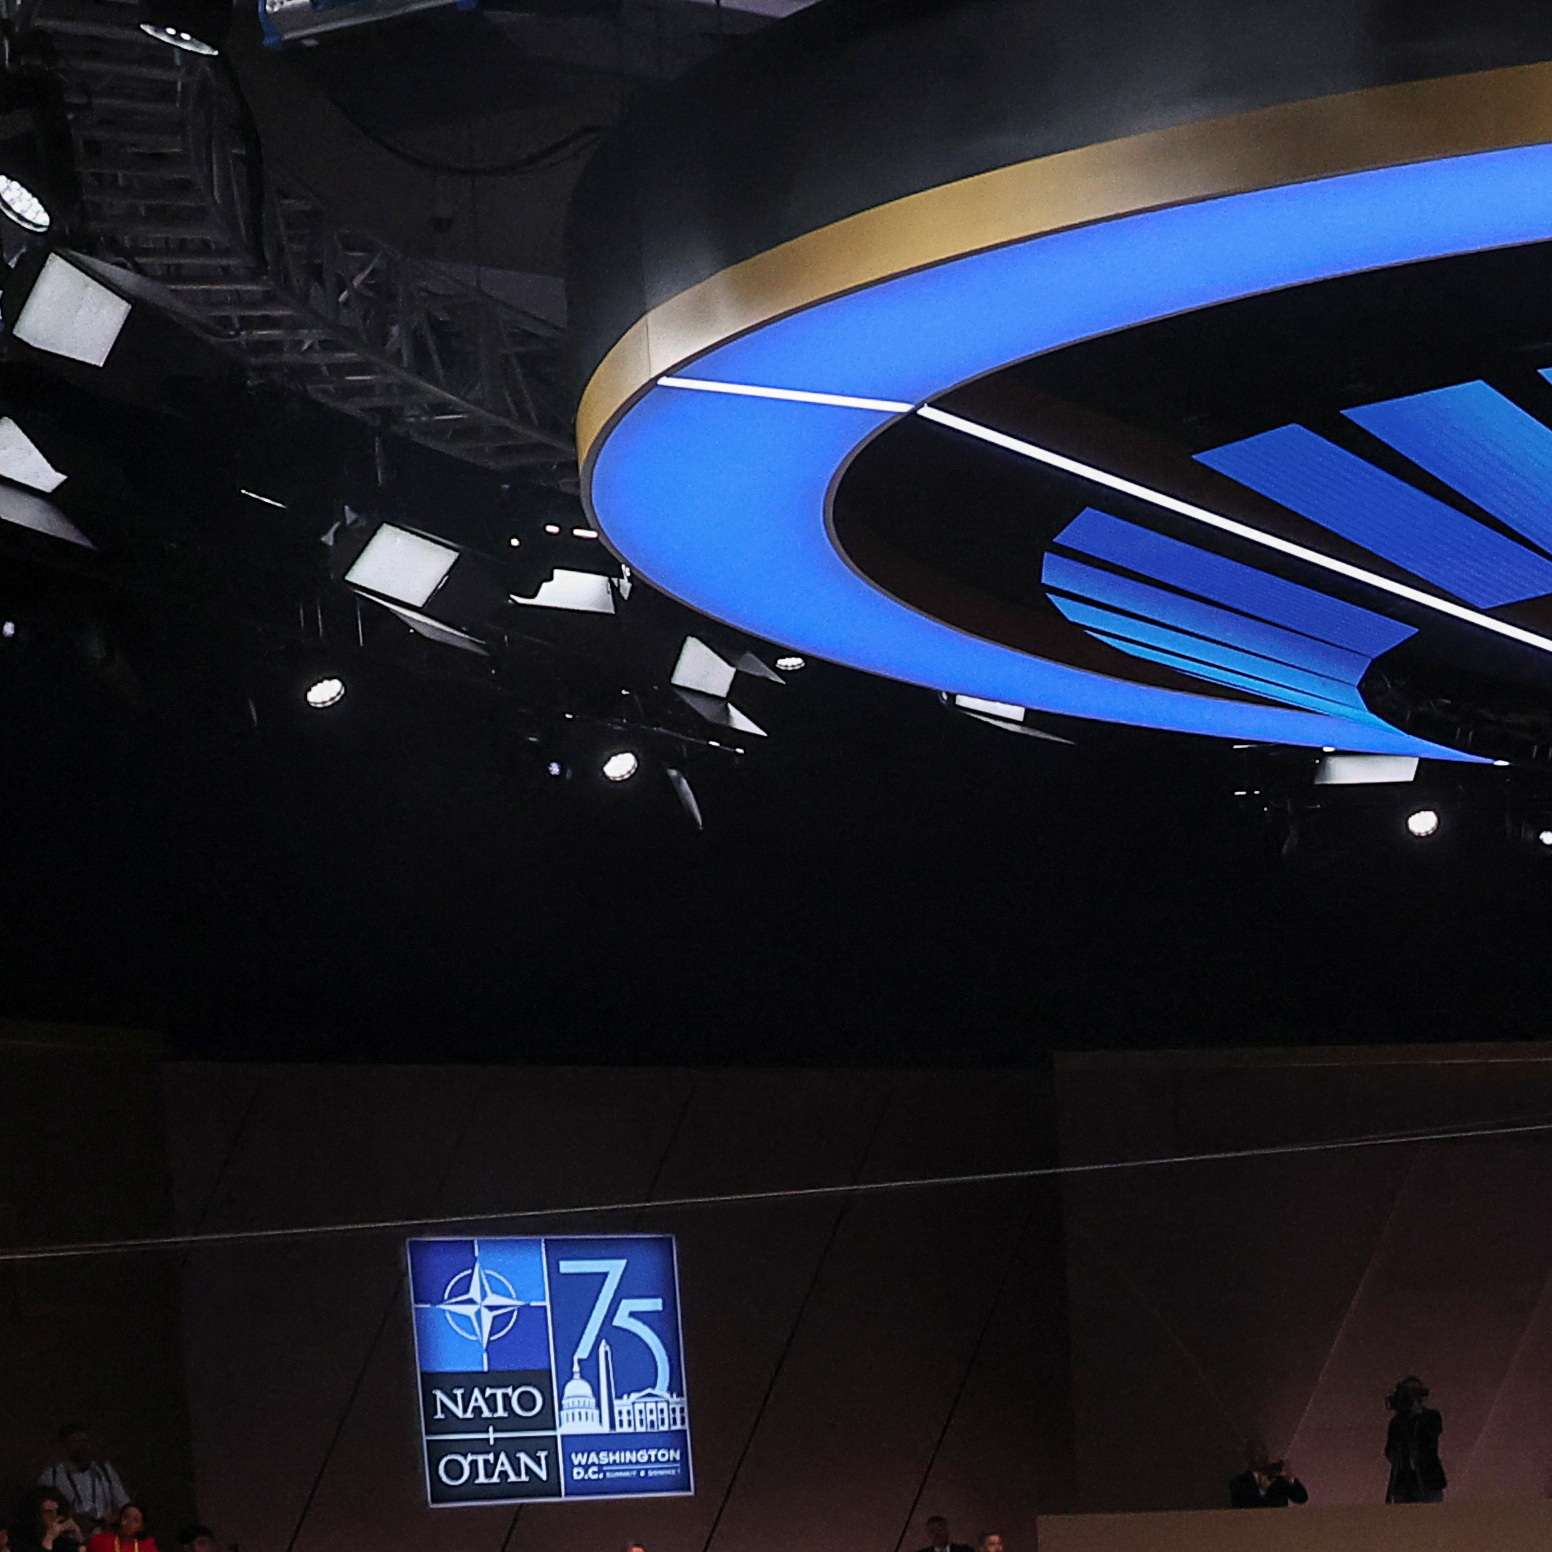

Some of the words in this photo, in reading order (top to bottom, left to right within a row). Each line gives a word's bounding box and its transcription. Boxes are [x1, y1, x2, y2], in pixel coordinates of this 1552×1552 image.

[559, 1259, 670, 1393] 75
[433, 1385, 543, 1420] NATO
[438, 1450, 549, 1486] OTAN
[571, 1448, 681, 1466] WASHINGTON
[572, 1465, 604, 1481] D.C.
